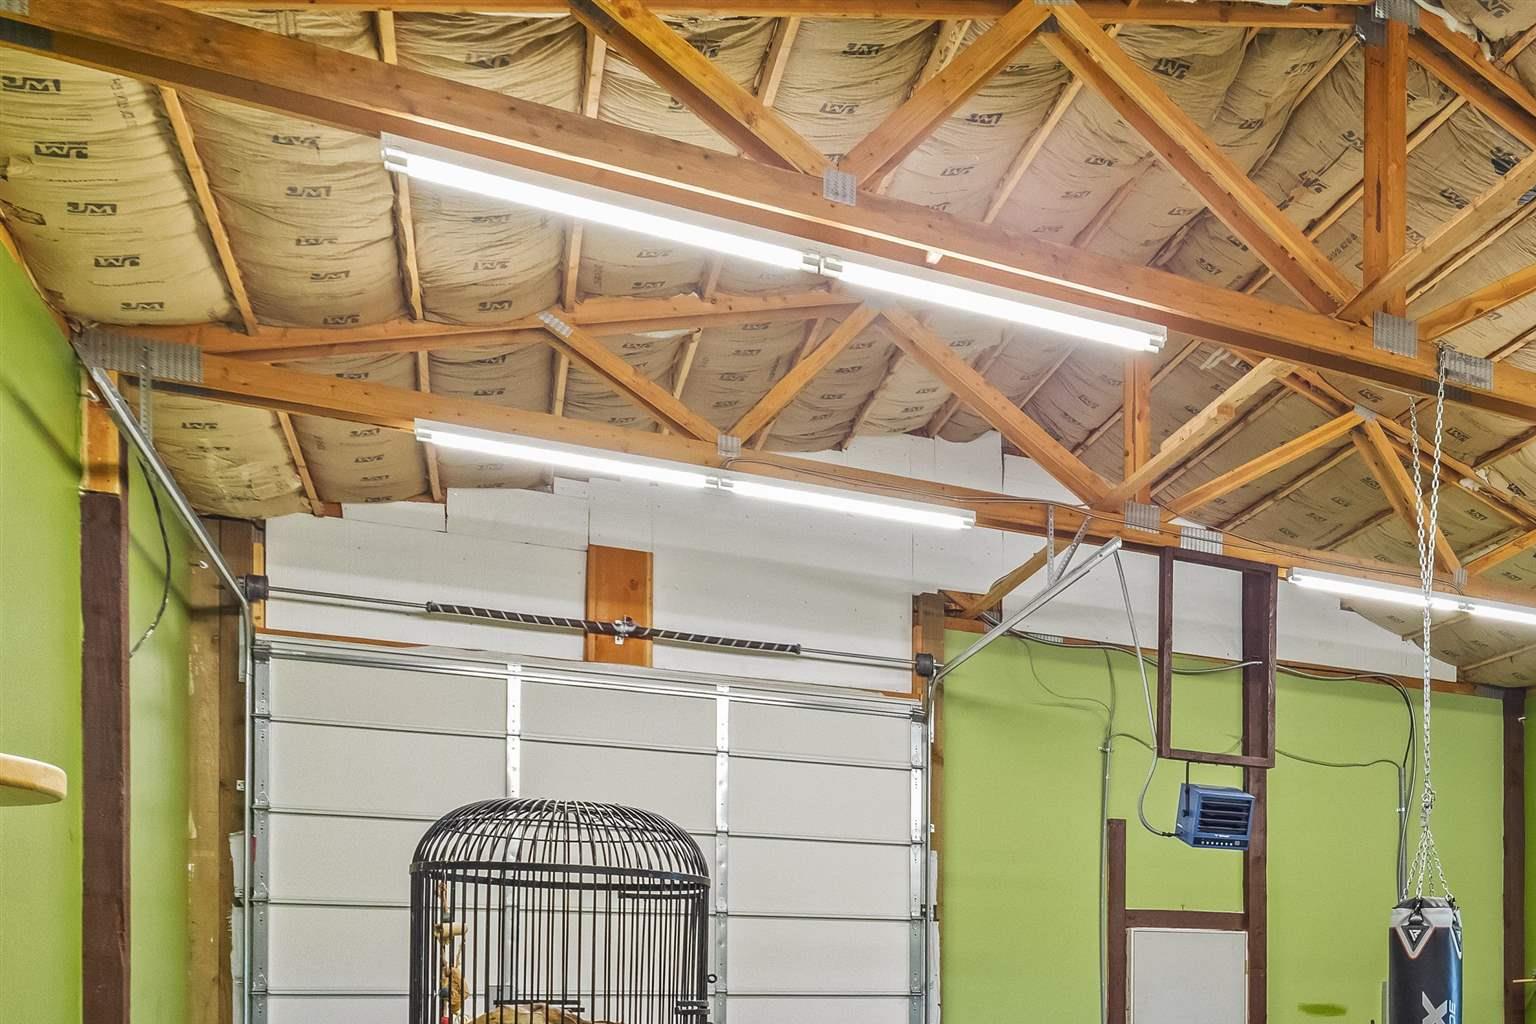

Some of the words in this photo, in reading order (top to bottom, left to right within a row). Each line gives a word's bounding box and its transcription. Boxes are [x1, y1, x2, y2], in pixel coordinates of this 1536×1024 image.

[1, 76, 61, 92] JM
[34, 144, 88, 159] JM
[67, 202, 117, 216] JM
[94, 257, 140, 267] JM
[120, 302, 164, 311] JM
